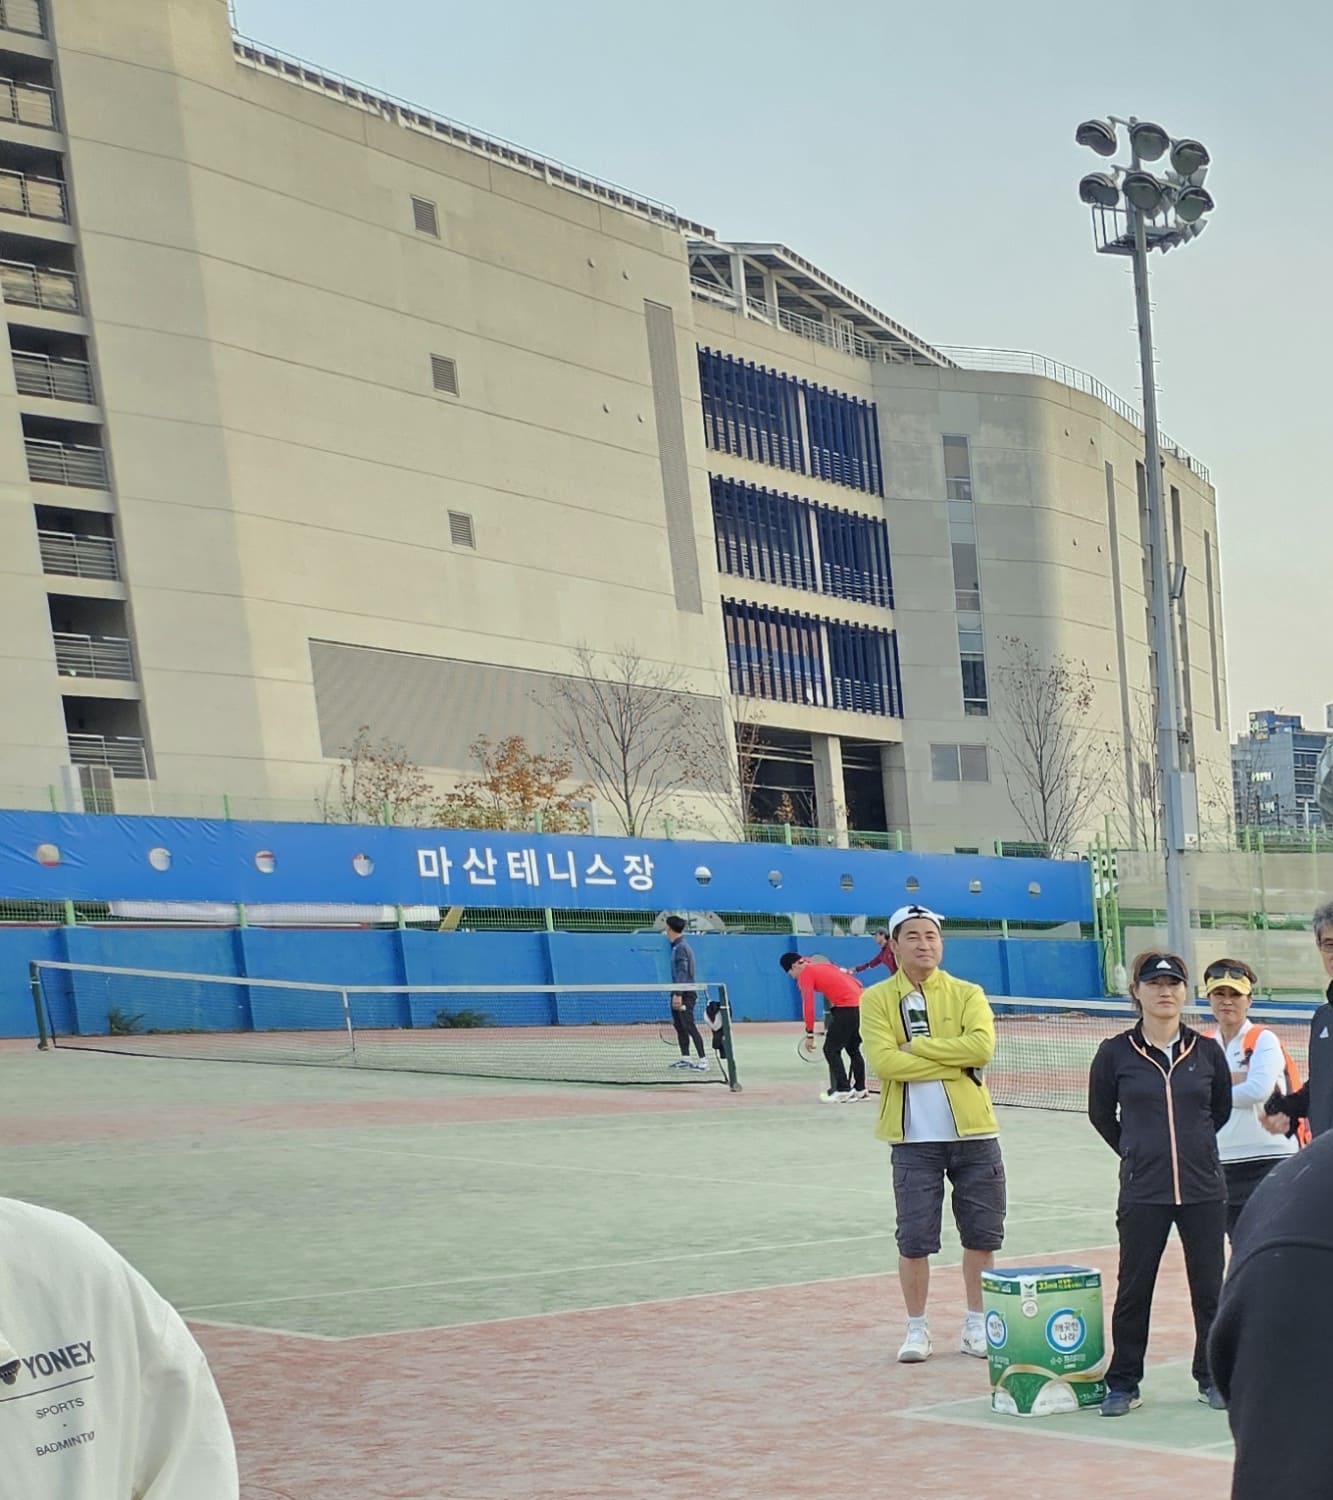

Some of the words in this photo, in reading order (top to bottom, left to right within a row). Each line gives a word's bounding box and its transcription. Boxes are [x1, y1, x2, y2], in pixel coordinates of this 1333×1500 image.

[417, 846, 655, 891] 마산테니스장
[22, 1340, 96, 1379] YONEX
[36, 1397, 85, 1419] SPORTS
